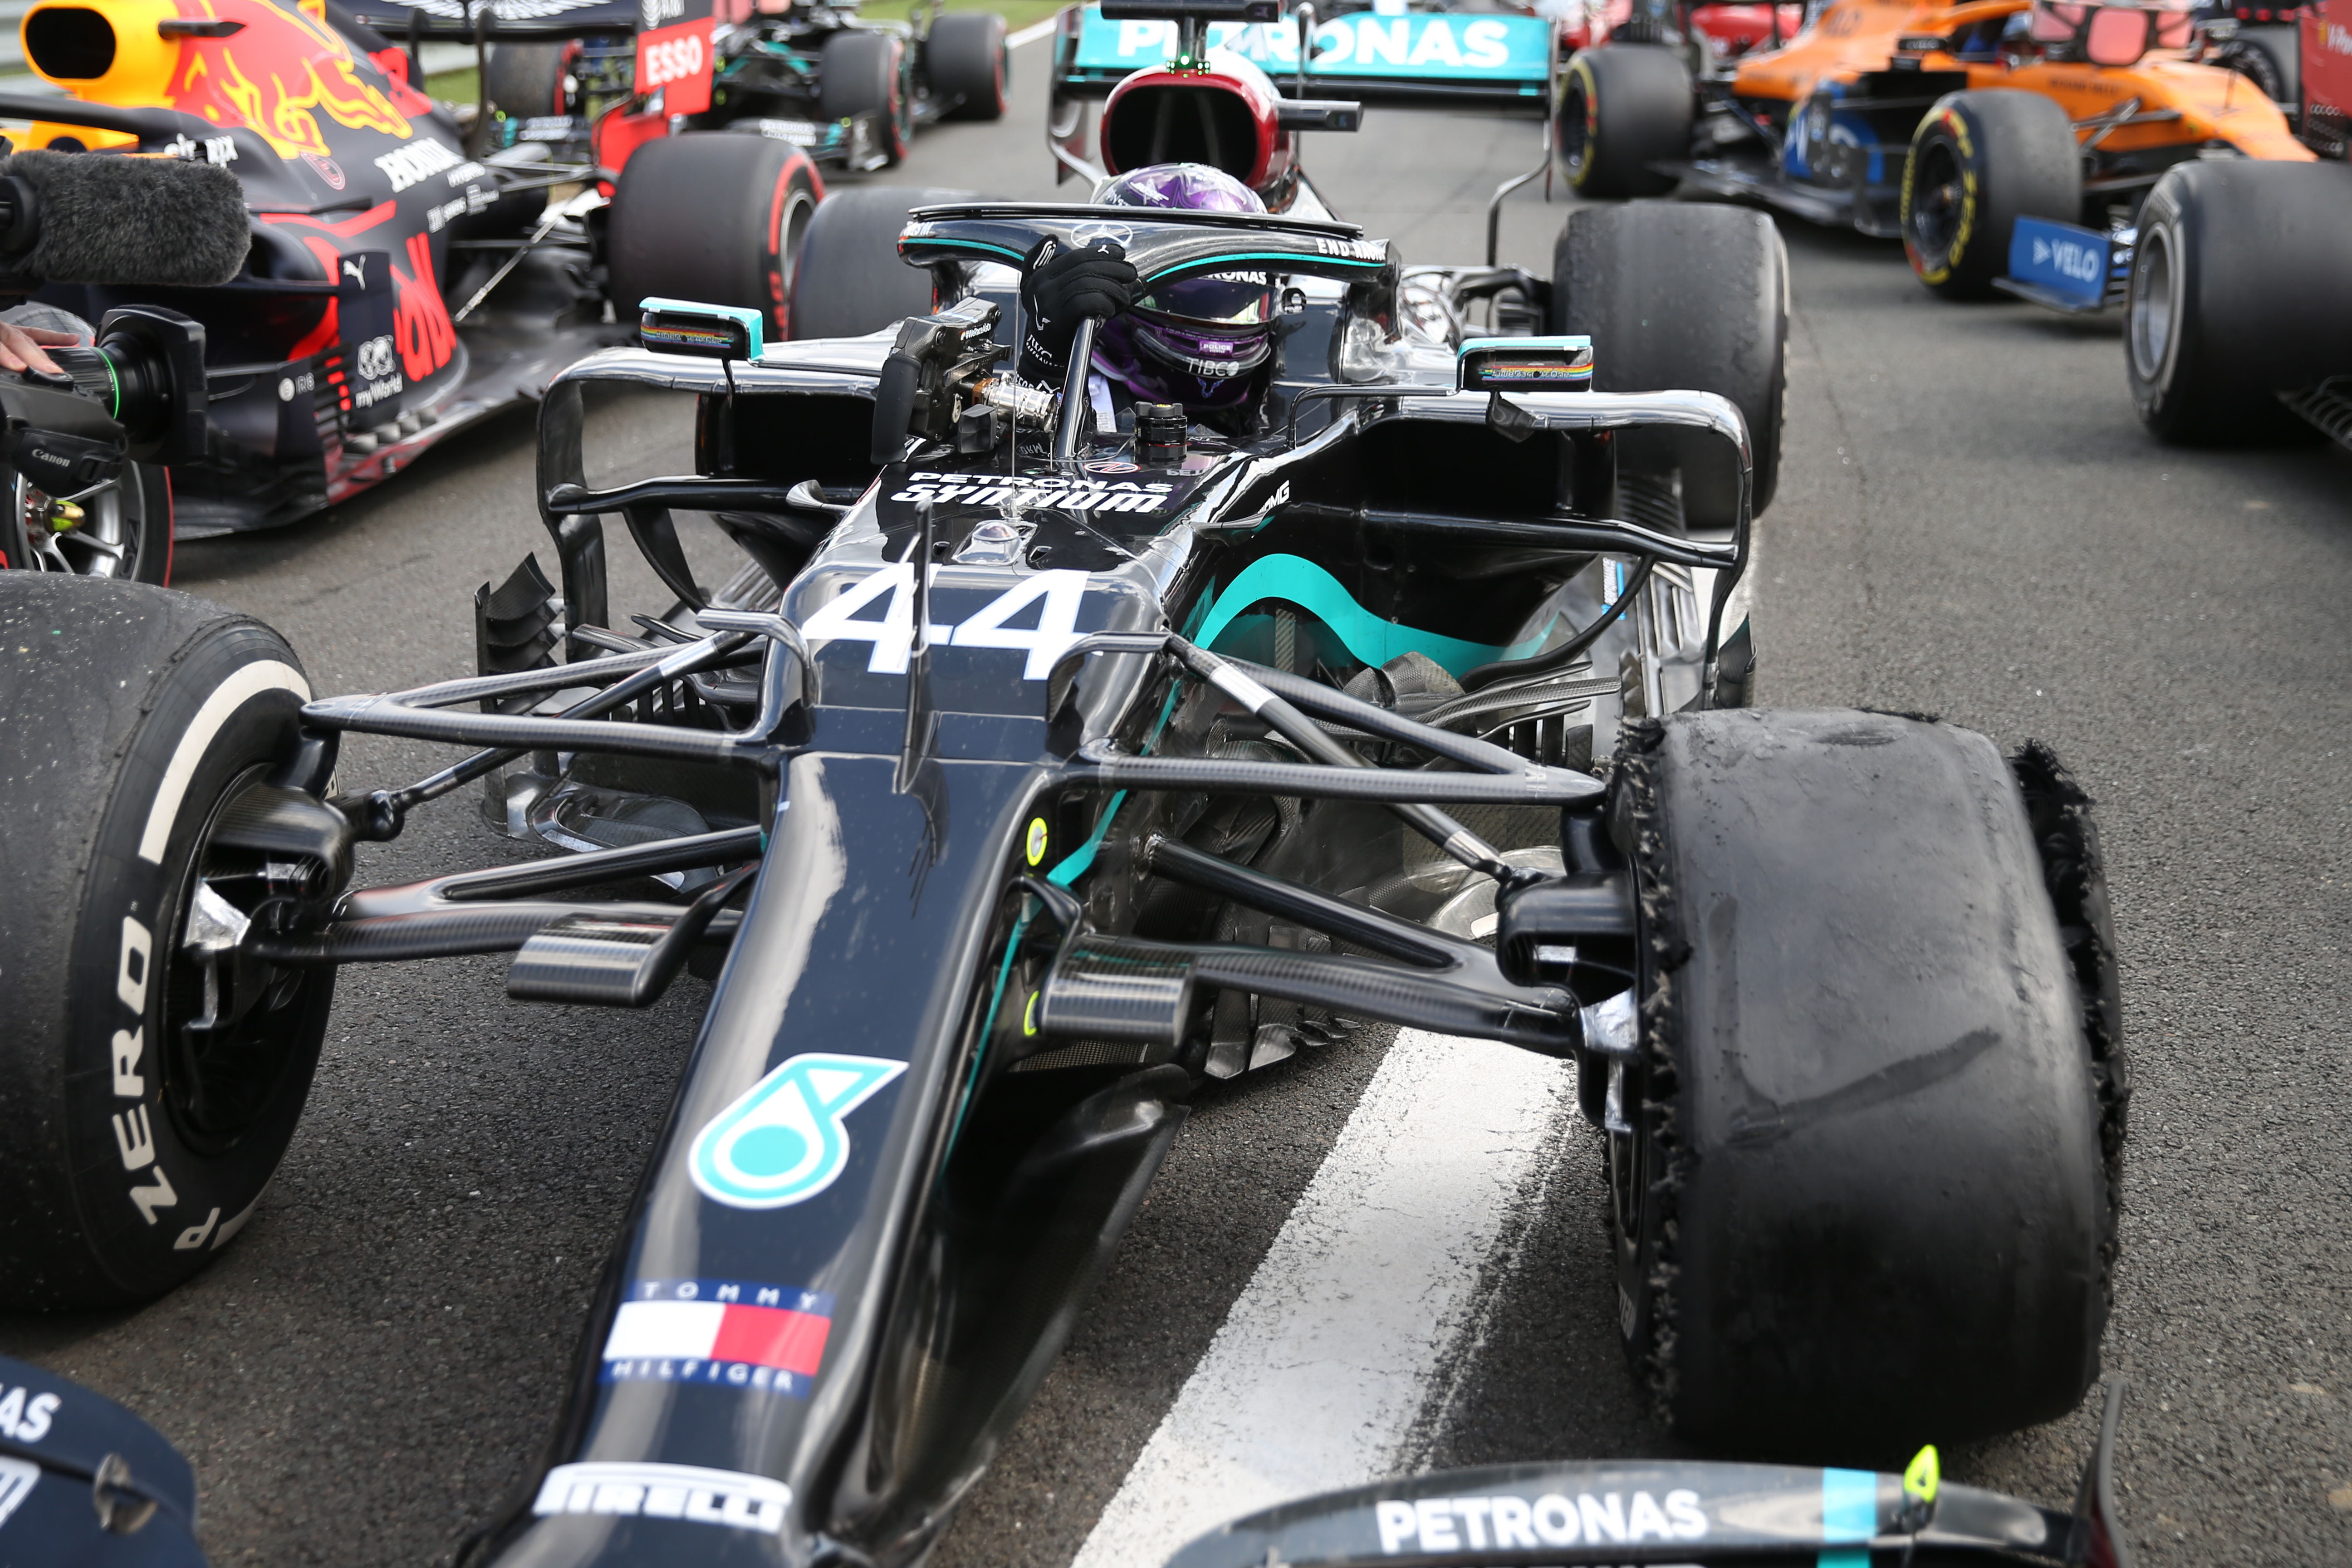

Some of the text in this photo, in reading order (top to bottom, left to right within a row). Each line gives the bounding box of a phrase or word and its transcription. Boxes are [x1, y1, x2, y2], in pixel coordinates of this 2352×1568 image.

[645, 34, 703, 87] ESSO
[1117, 19, 1509, 68] PRONAS
[1315, 237, 1350, 257] END
[2051, 238, 2100, 283] VELO
[1203, 343, 1231, 351] POLICE
[355, 372, 403, 408] myWorld
[32, 449, 70, 467] Canon
[891, 484, 1168, 513] SYNTIUM
[908, 472, 1173, 493] PETRONAS
[1263, 480, 1289, 512] AMG
[800, 562, 1104, 681] 44
[644, 1280, 819, 1310] TOMMY
[612, 1361, 794, 1392] HILFIGER
[0, 1383, 62, 1443] AS
[531, 1461, 793, 1534] PIRELLI
[1375, 1489, 1710, 1554] PETRONAS
